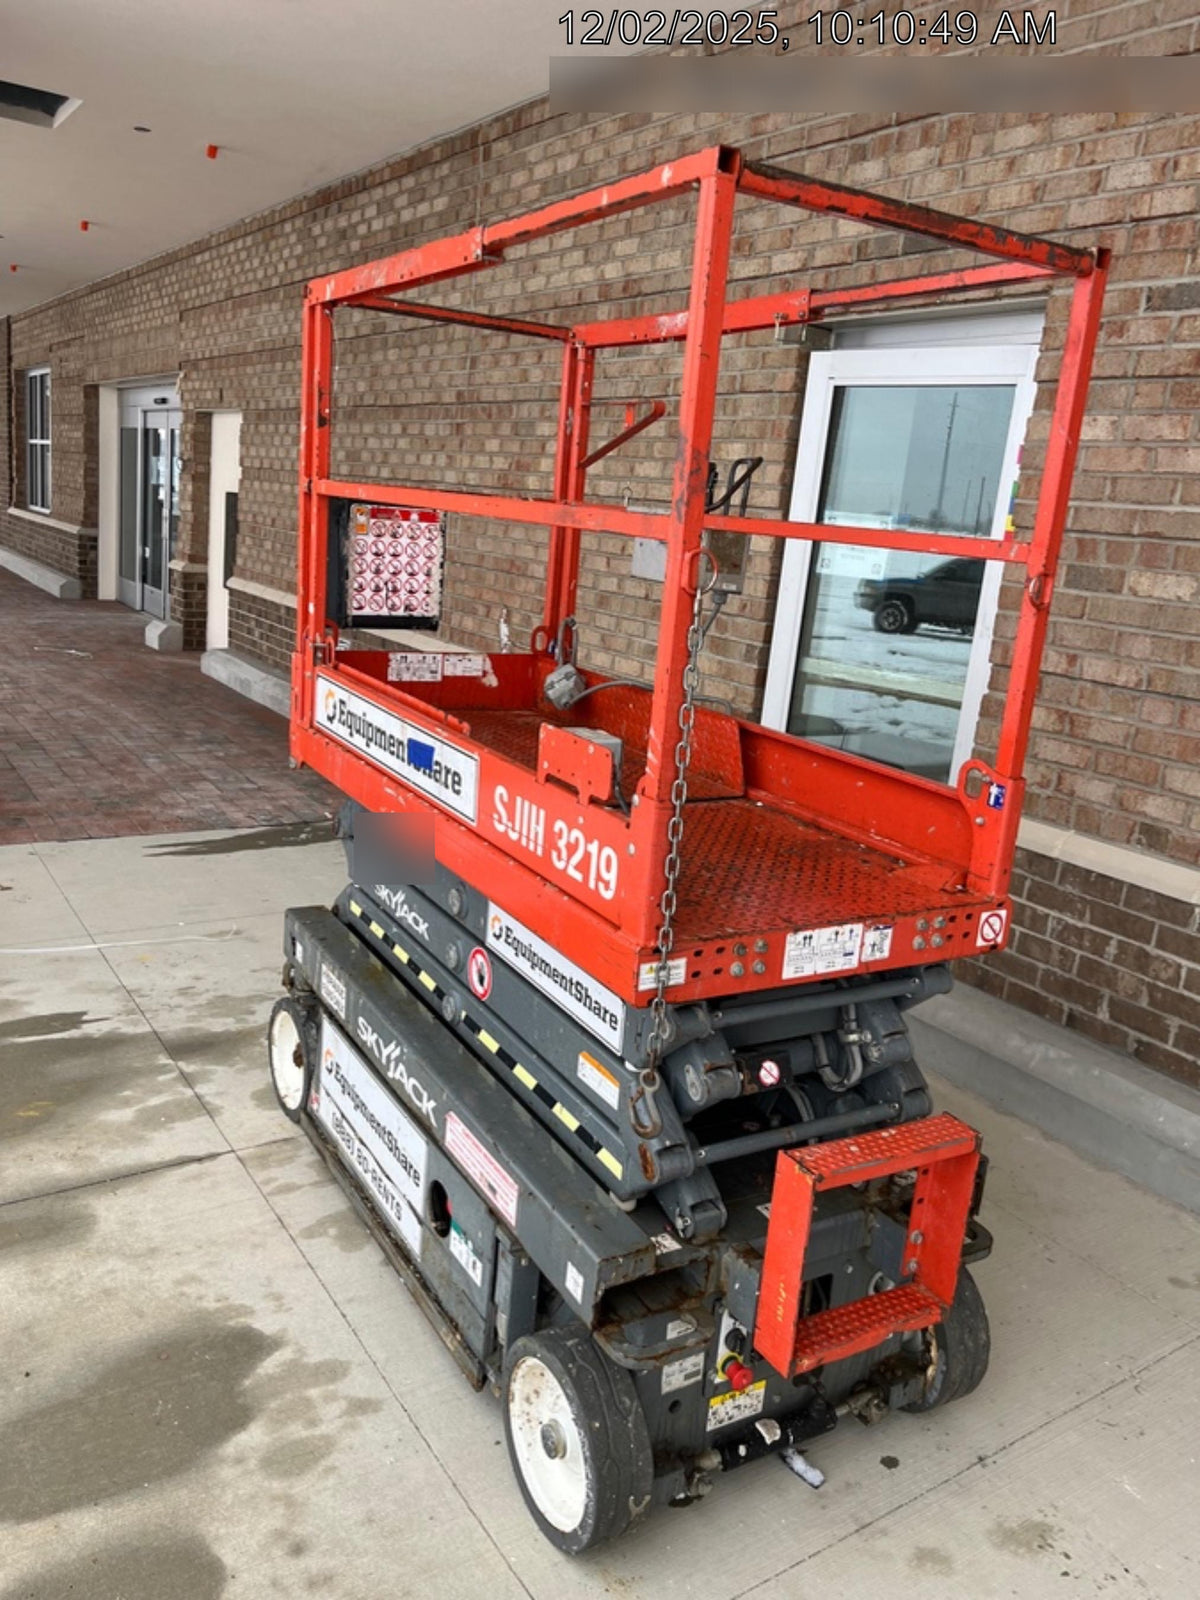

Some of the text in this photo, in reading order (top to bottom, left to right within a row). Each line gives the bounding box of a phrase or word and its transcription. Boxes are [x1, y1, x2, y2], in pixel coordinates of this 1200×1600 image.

[338, 699, 462, 795] Equipmenare
[551, 818, 619, 901] 3219
[503, 923, 619, 1032] EquipmentShare
[333, 1060, 421, 1188] EquipmentShare
[357, 1015, 437, 1128] SKYJACK
